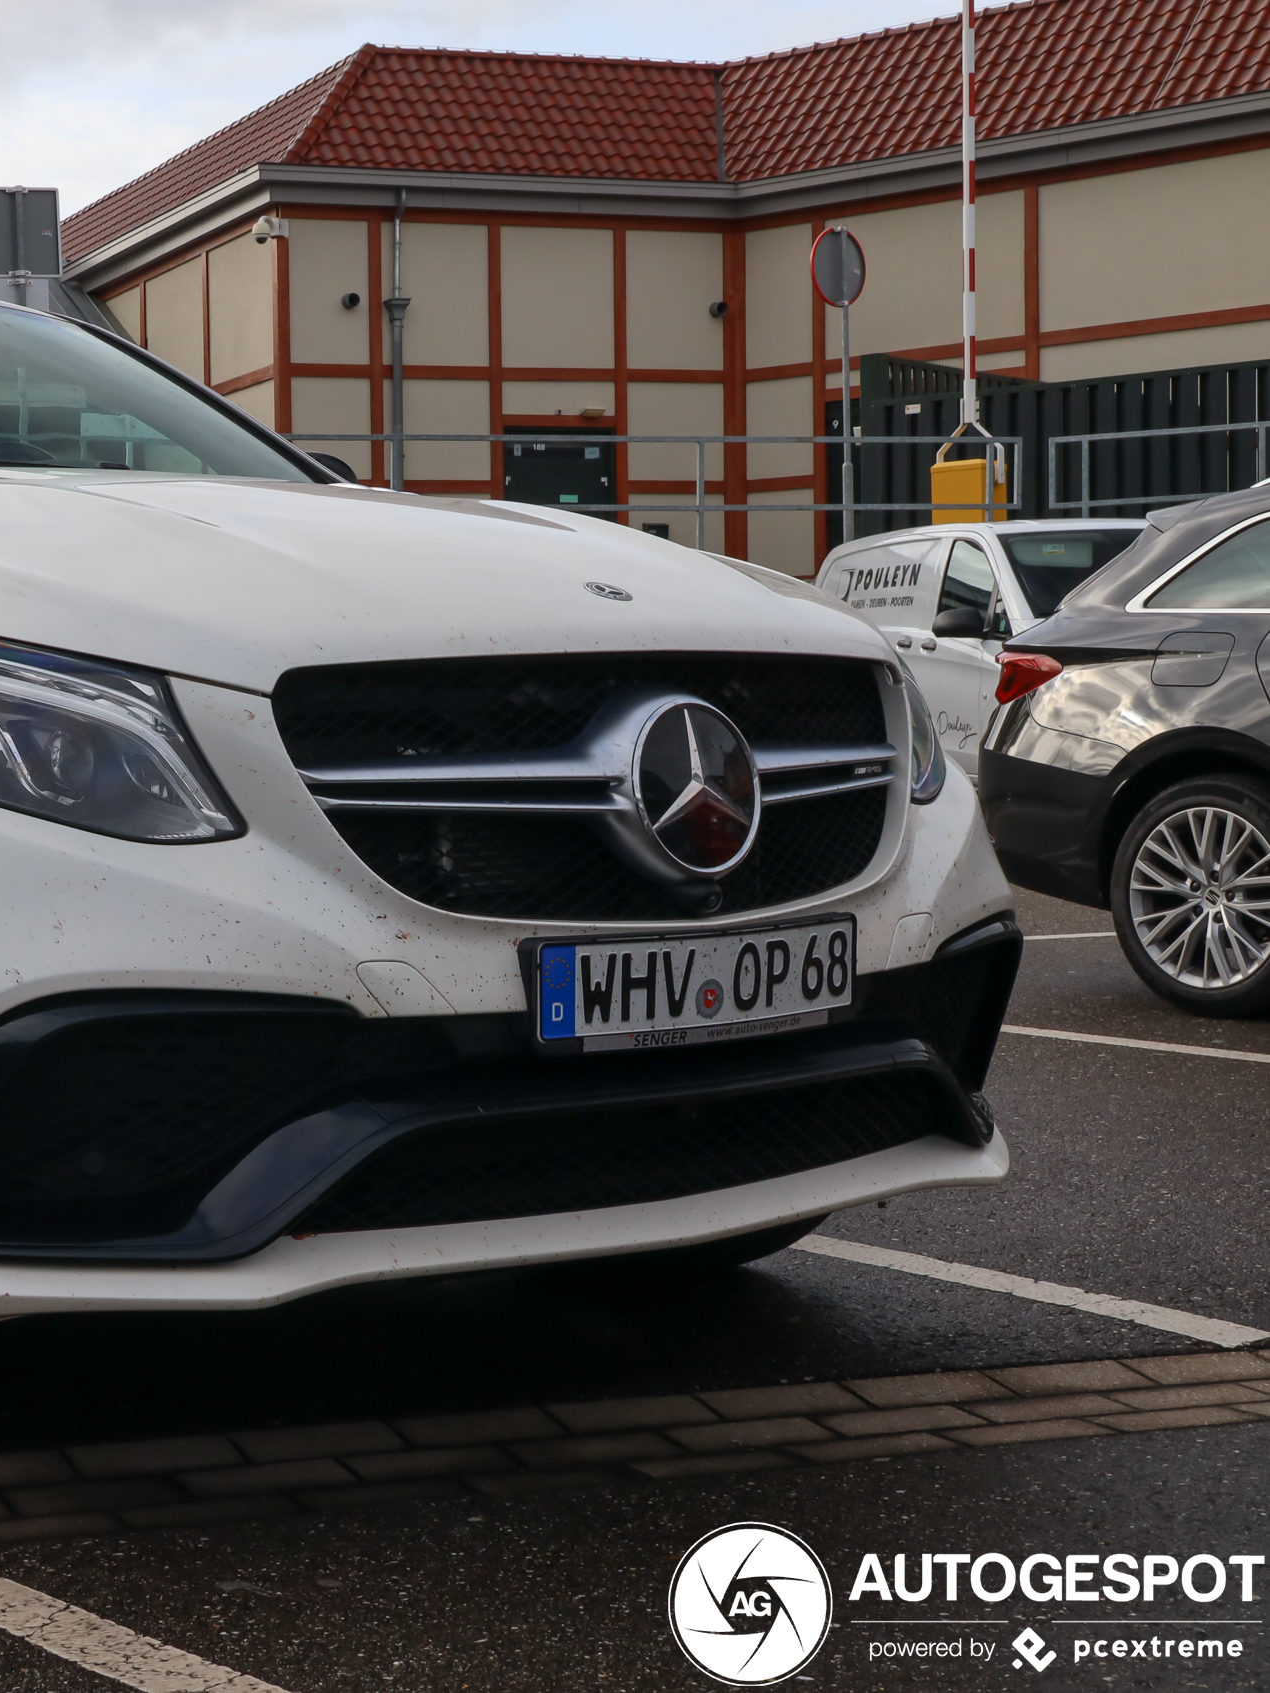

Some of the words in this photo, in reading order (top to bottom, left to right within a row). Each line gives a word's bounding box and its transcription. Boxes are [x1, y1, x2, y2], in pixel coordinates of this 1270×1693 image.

[833, 420, 839, 429] 9
[854, 563, 922, 591] POULEYN
[890, 596, 914, 607] POORTEN
[580, 948, 696, 1024] WHV
[732, 938, 791, 1011] OP
[801, 929, 849, 1001] 68
[551, 1002, 564, 1022] D
[706, 1016, 802, 1039] www.auto-senger.de
[633, 1031, 688, 1048] SENGER
